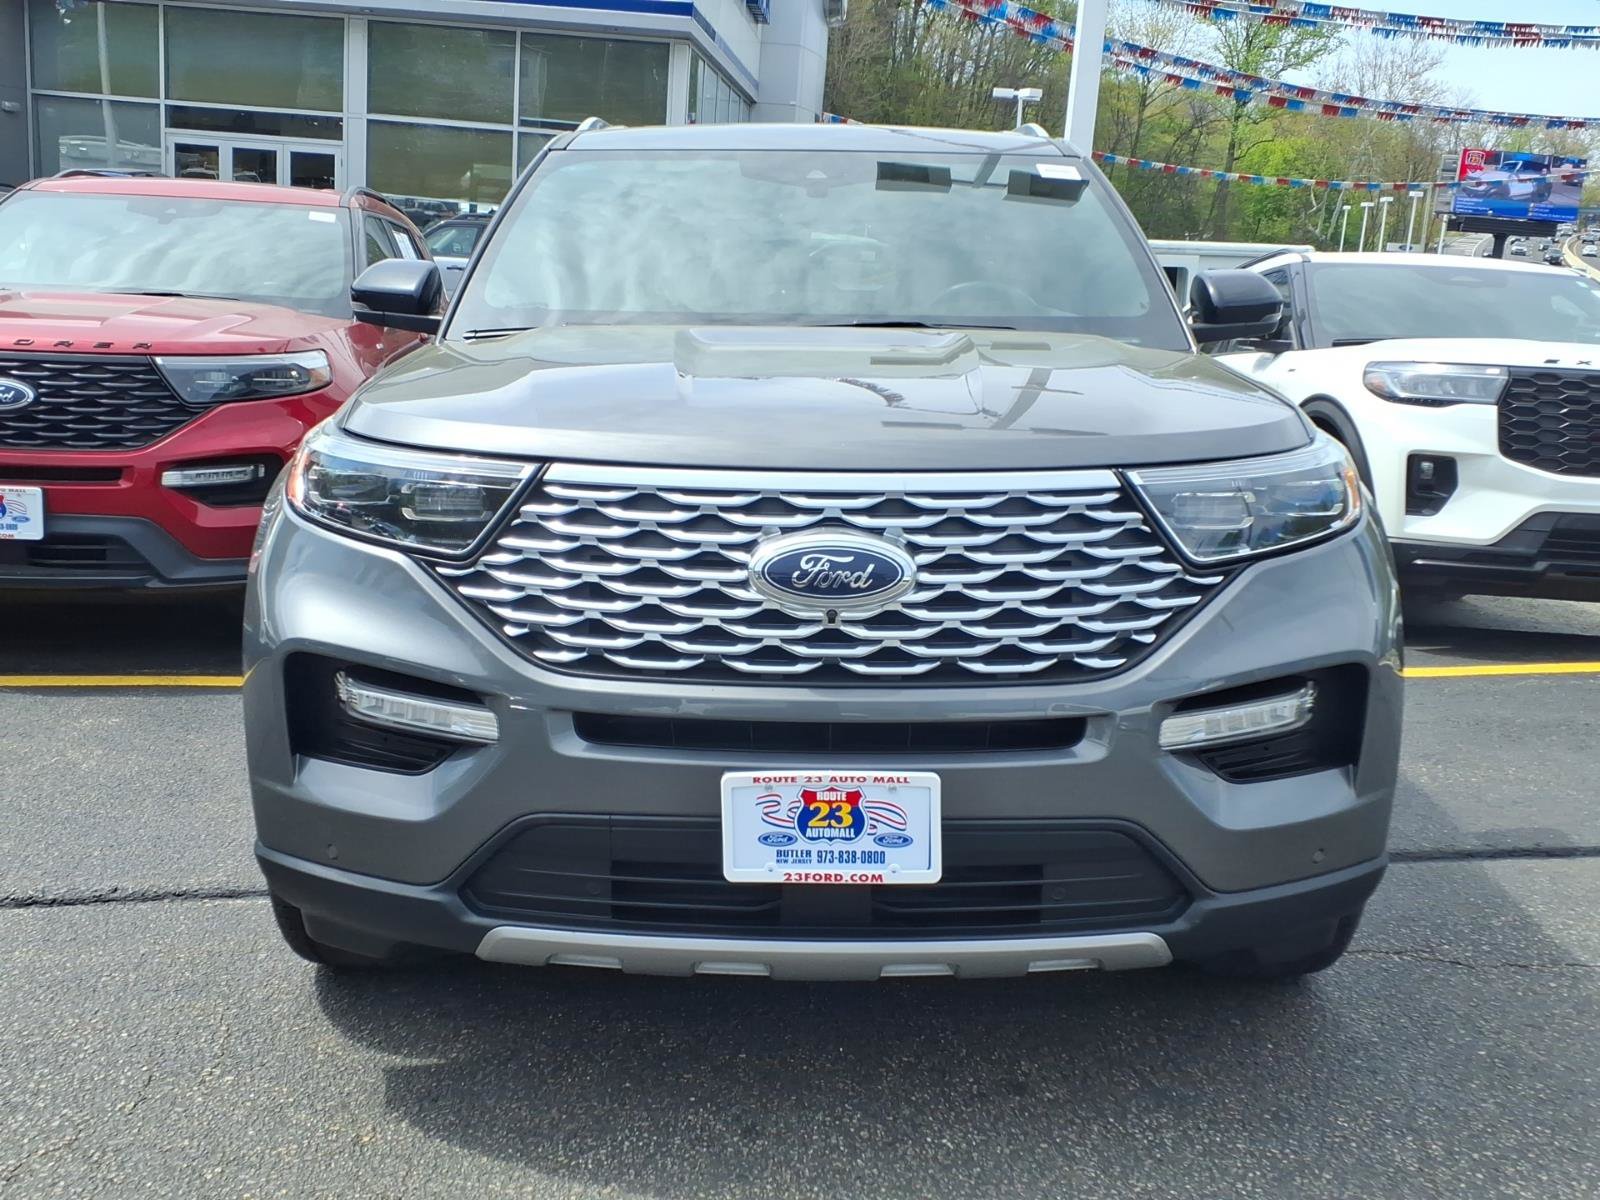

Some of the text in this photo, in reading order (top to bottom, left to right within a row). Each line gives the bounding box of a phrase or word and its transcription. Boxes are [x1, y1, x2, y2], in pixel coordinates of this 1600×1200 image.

[791, 553, 876, 589] Ford
[753, 776, 797, 784] ROUTE
[829, 776, 867, 784] AUTO
[816, 791, 847, 801] ROUTE
[808, 801, 853, 828] 23
[805, 828, 855, 838] AUTOMALL
[767, 835, 788, 843] Ford
[882, 835, 903, 844] Ford
[776, 849, 812, 858] BUTLER
[817, 850, 886, 865] 973-838-0800
[783, 872, 884, 883] 23FORD.COM
